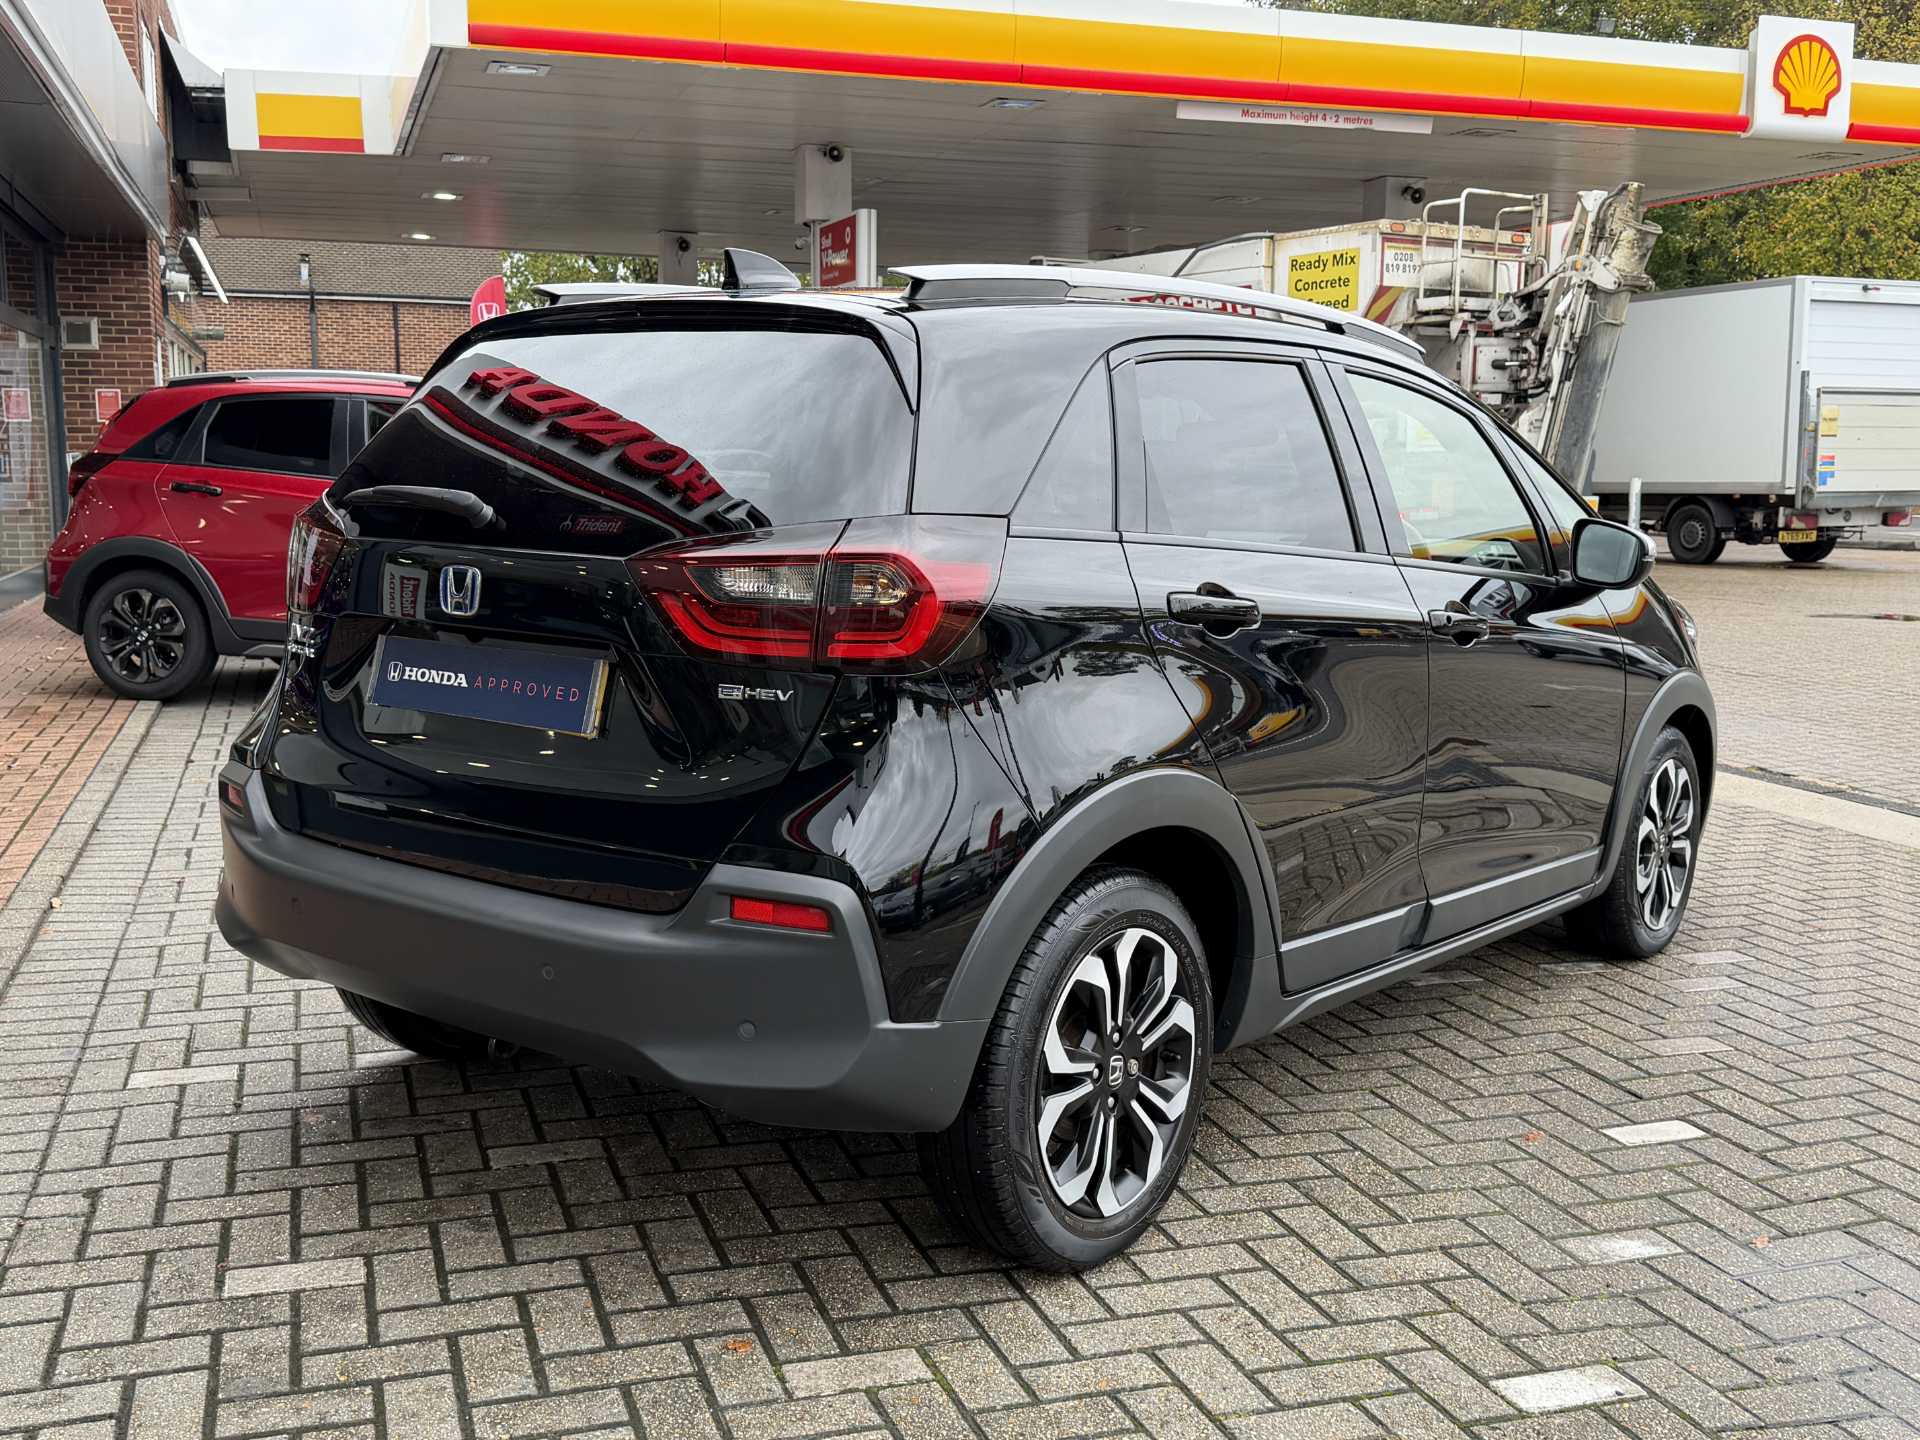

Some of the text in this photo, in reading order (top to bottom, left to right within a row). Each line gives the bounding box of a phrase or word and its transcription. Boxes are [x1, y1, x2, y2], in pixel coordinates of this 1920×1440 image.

[1241, 108, 1287, 120] Maximum
[1290, 110, 1319, 123] height
[1343, 115, 1374, 126] metres
[1290, 250, 1357, 273] Ready Mix
[1393, 252, 1414, 263] 0208
[1385, 264, 1401, 275] 819
[1294, 275, 1351, 292] Concrete
[1308, 294, 1350, 309] reed
[576, 517, 622, 533] Trident
[404, 666, 580, 702] HONDA APPROVED
